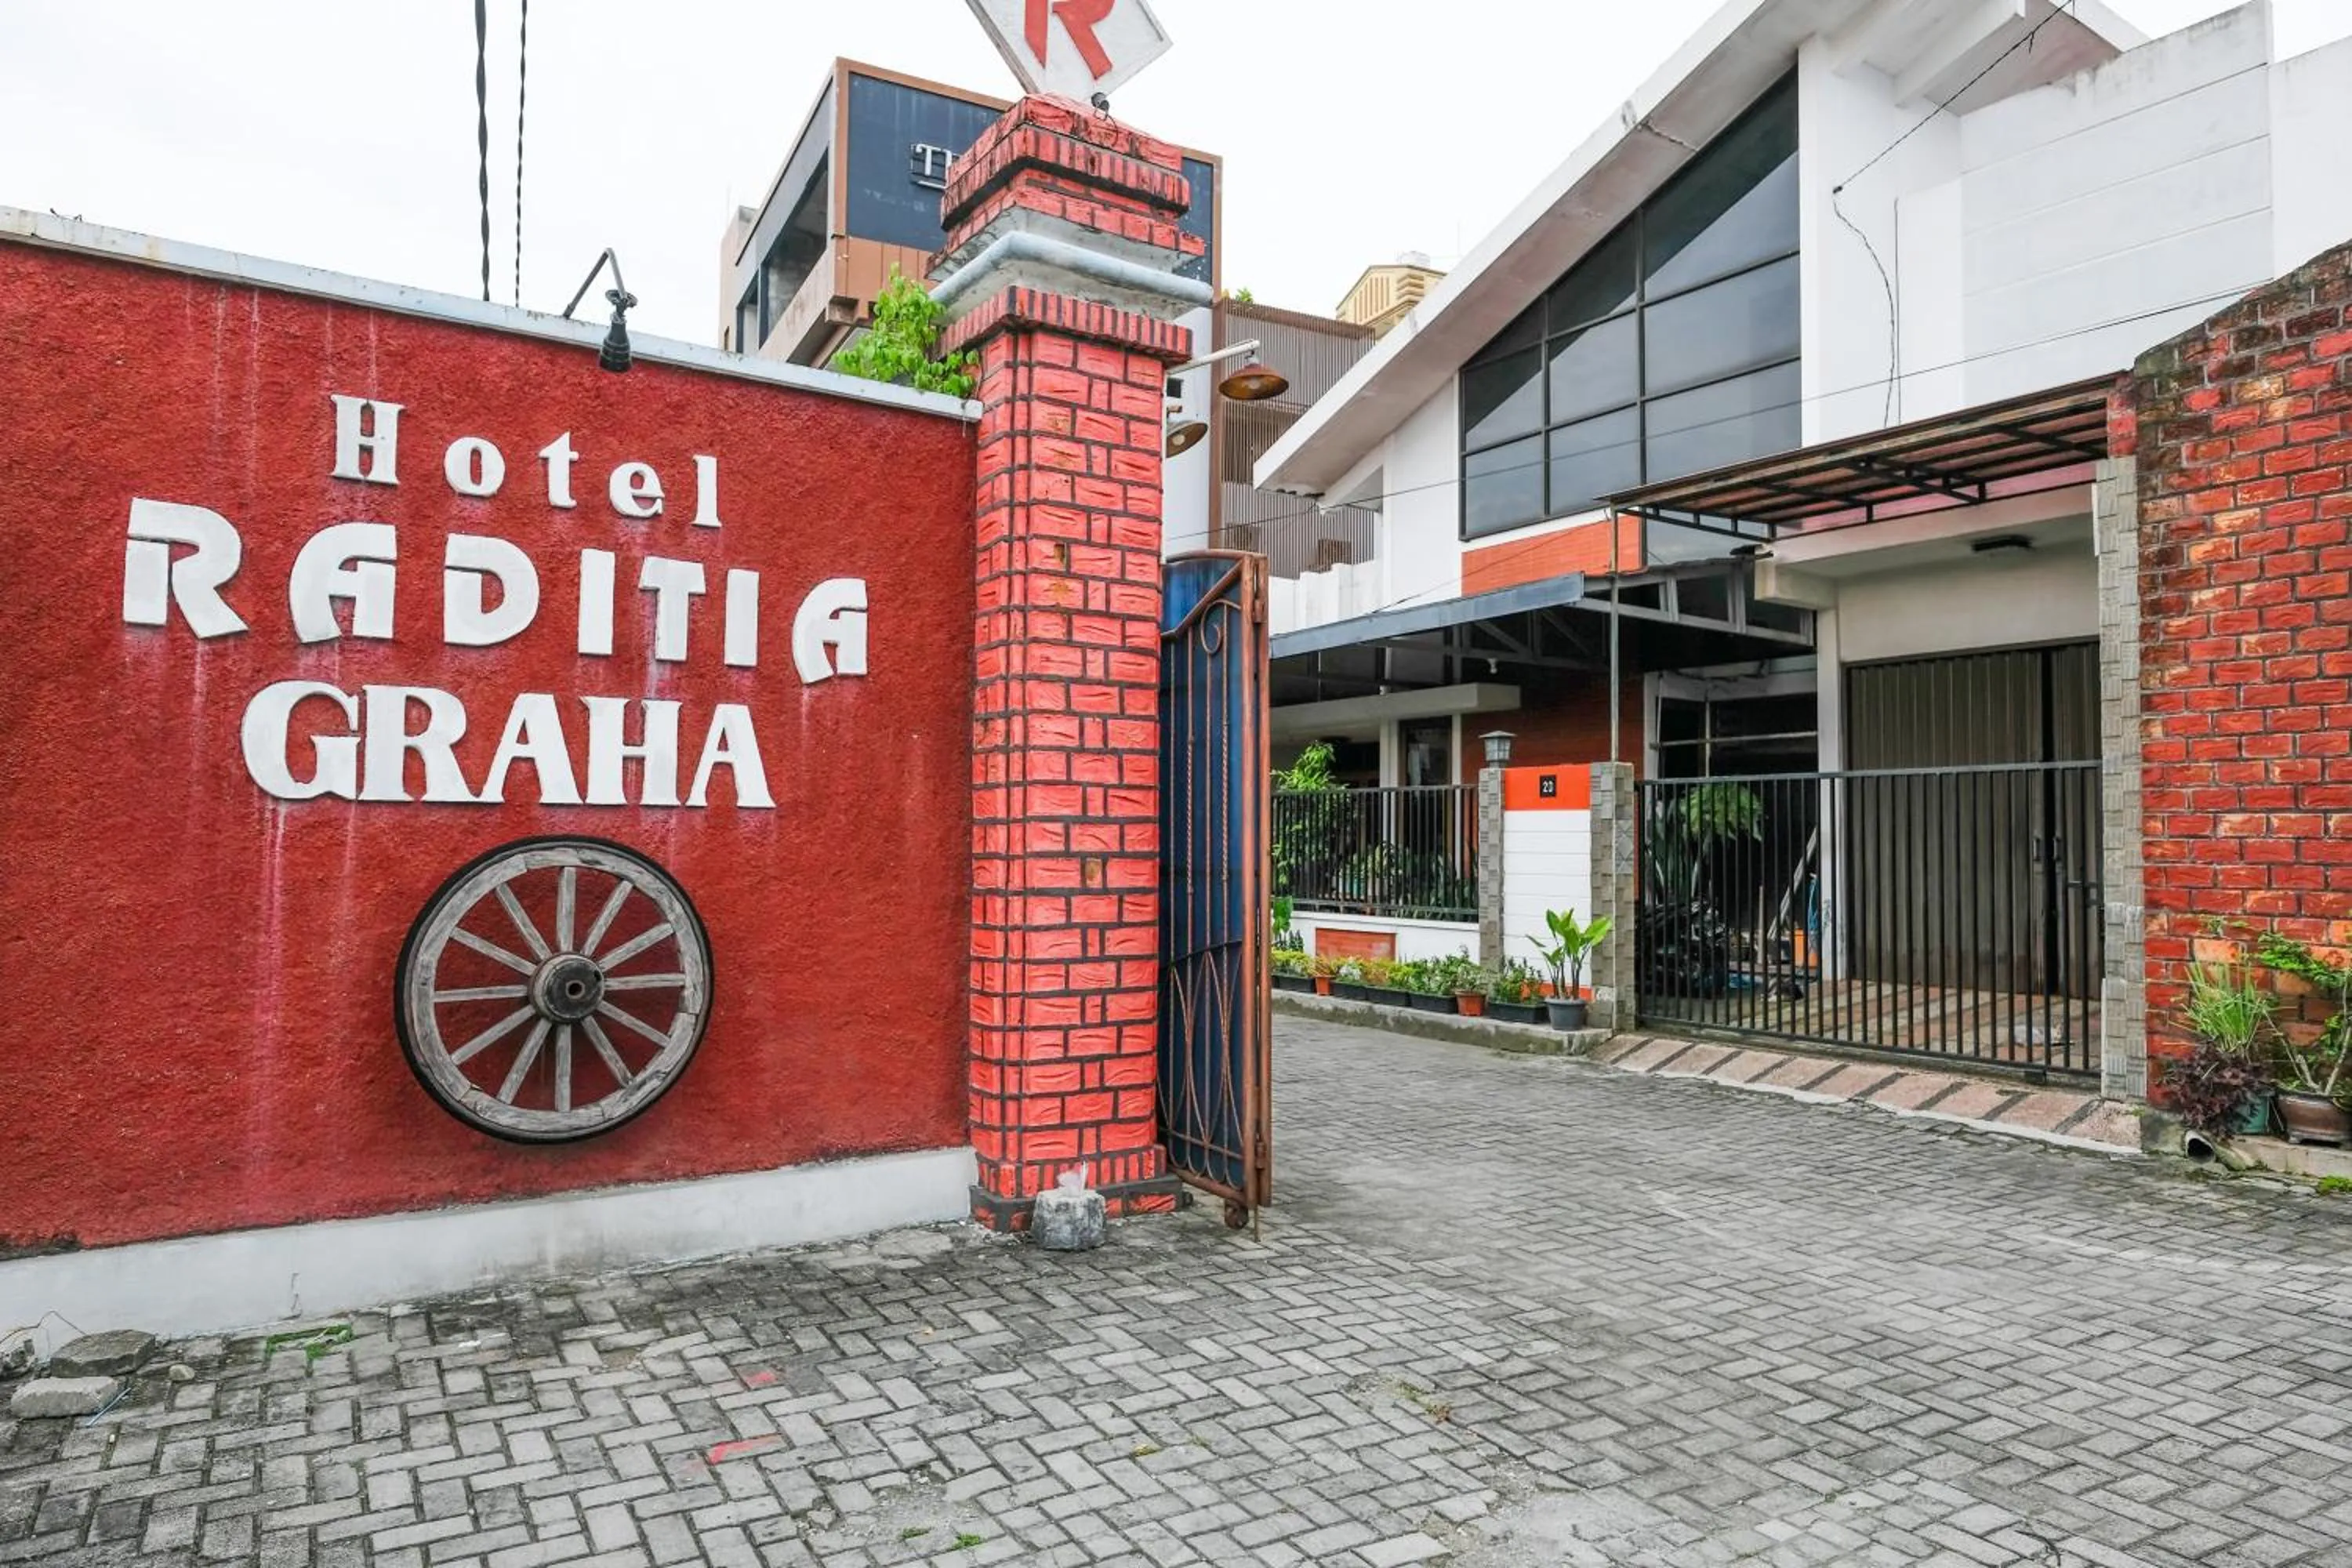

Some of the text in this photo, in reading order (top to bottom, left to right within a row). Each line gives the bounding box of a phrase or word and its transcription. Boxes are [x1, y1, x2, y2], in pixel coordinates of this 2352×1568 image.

[329, 393, 723, 528] Hotel
[122, 495, 869, 684] RADITIA
[240, 679, 776, 808] GRAHA
